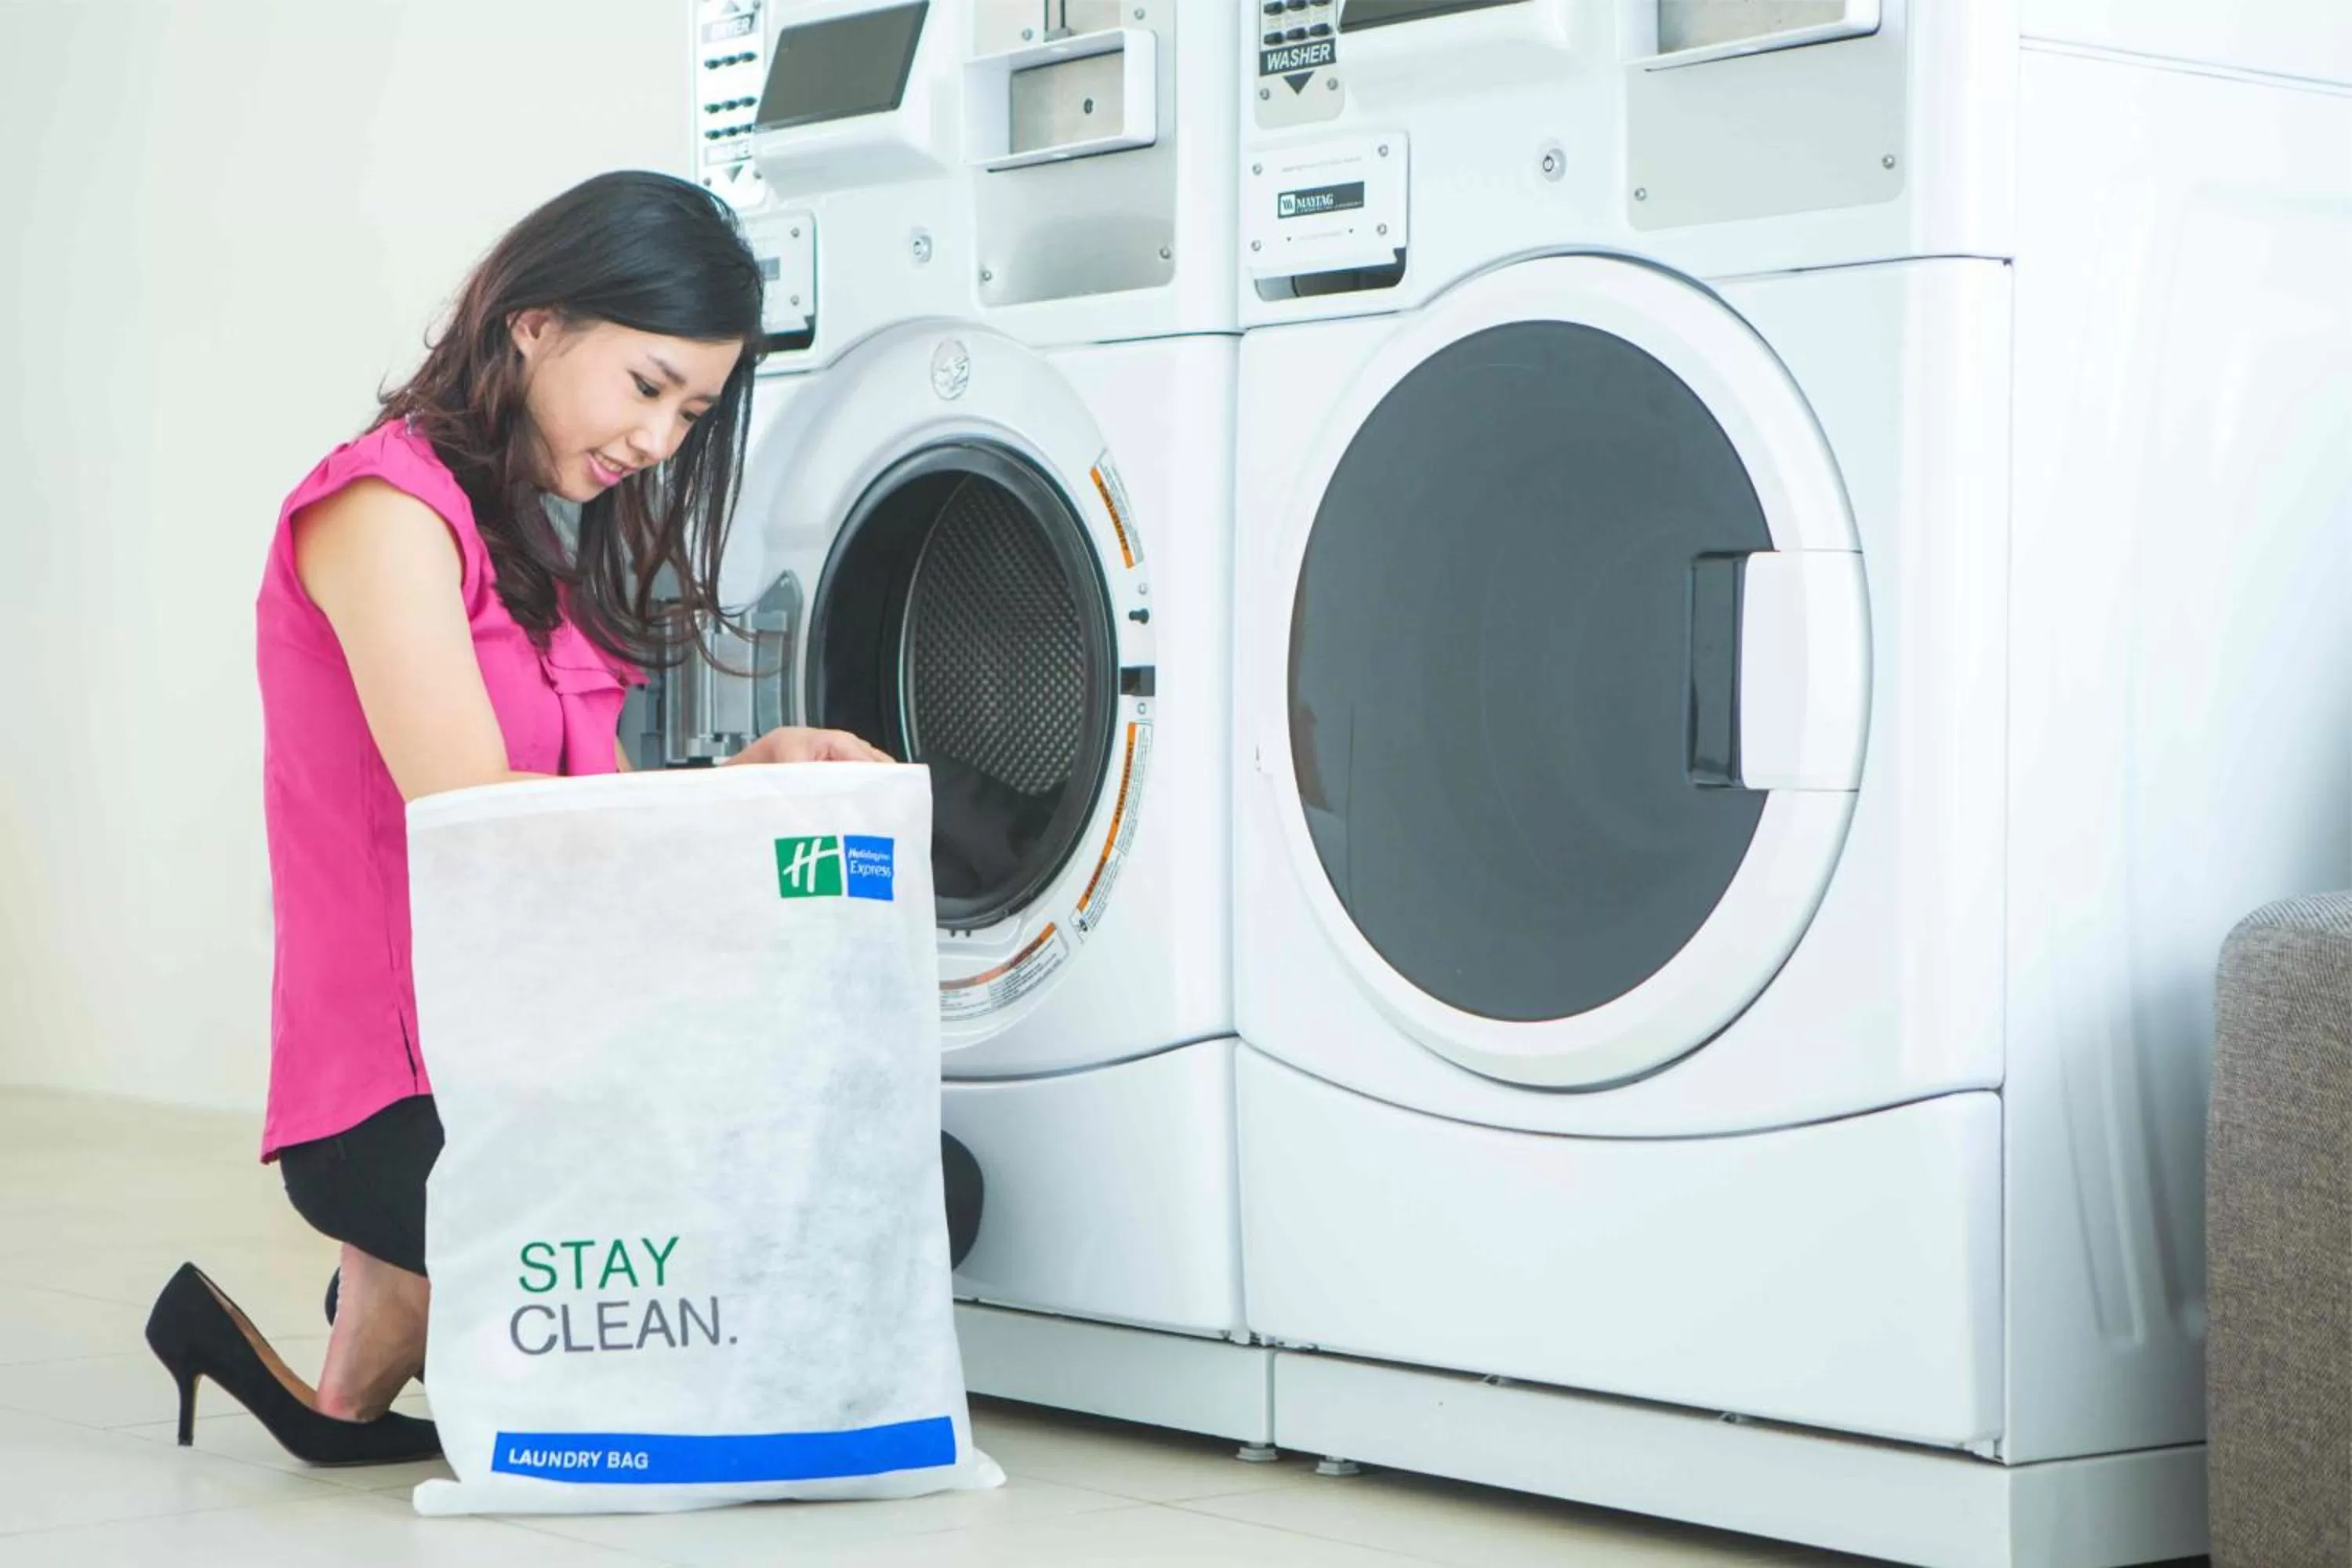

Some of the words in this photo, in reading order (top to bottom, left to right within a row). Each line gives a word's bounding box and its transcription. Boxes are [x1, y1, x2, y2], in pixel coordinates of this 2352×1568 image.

[1267, 43, 1331, 72] WASHER
[1296, 193, 1334, 209] MAYTAG
[850, 860, 891, 878] Express
[519, 1236, 679, 1293] STAY
[510, 1296, 737, 1355] CLEAN.
[508, 1448, 603, 1468] LAUNDRY
[607, 1451, 649, 1470] BAG
